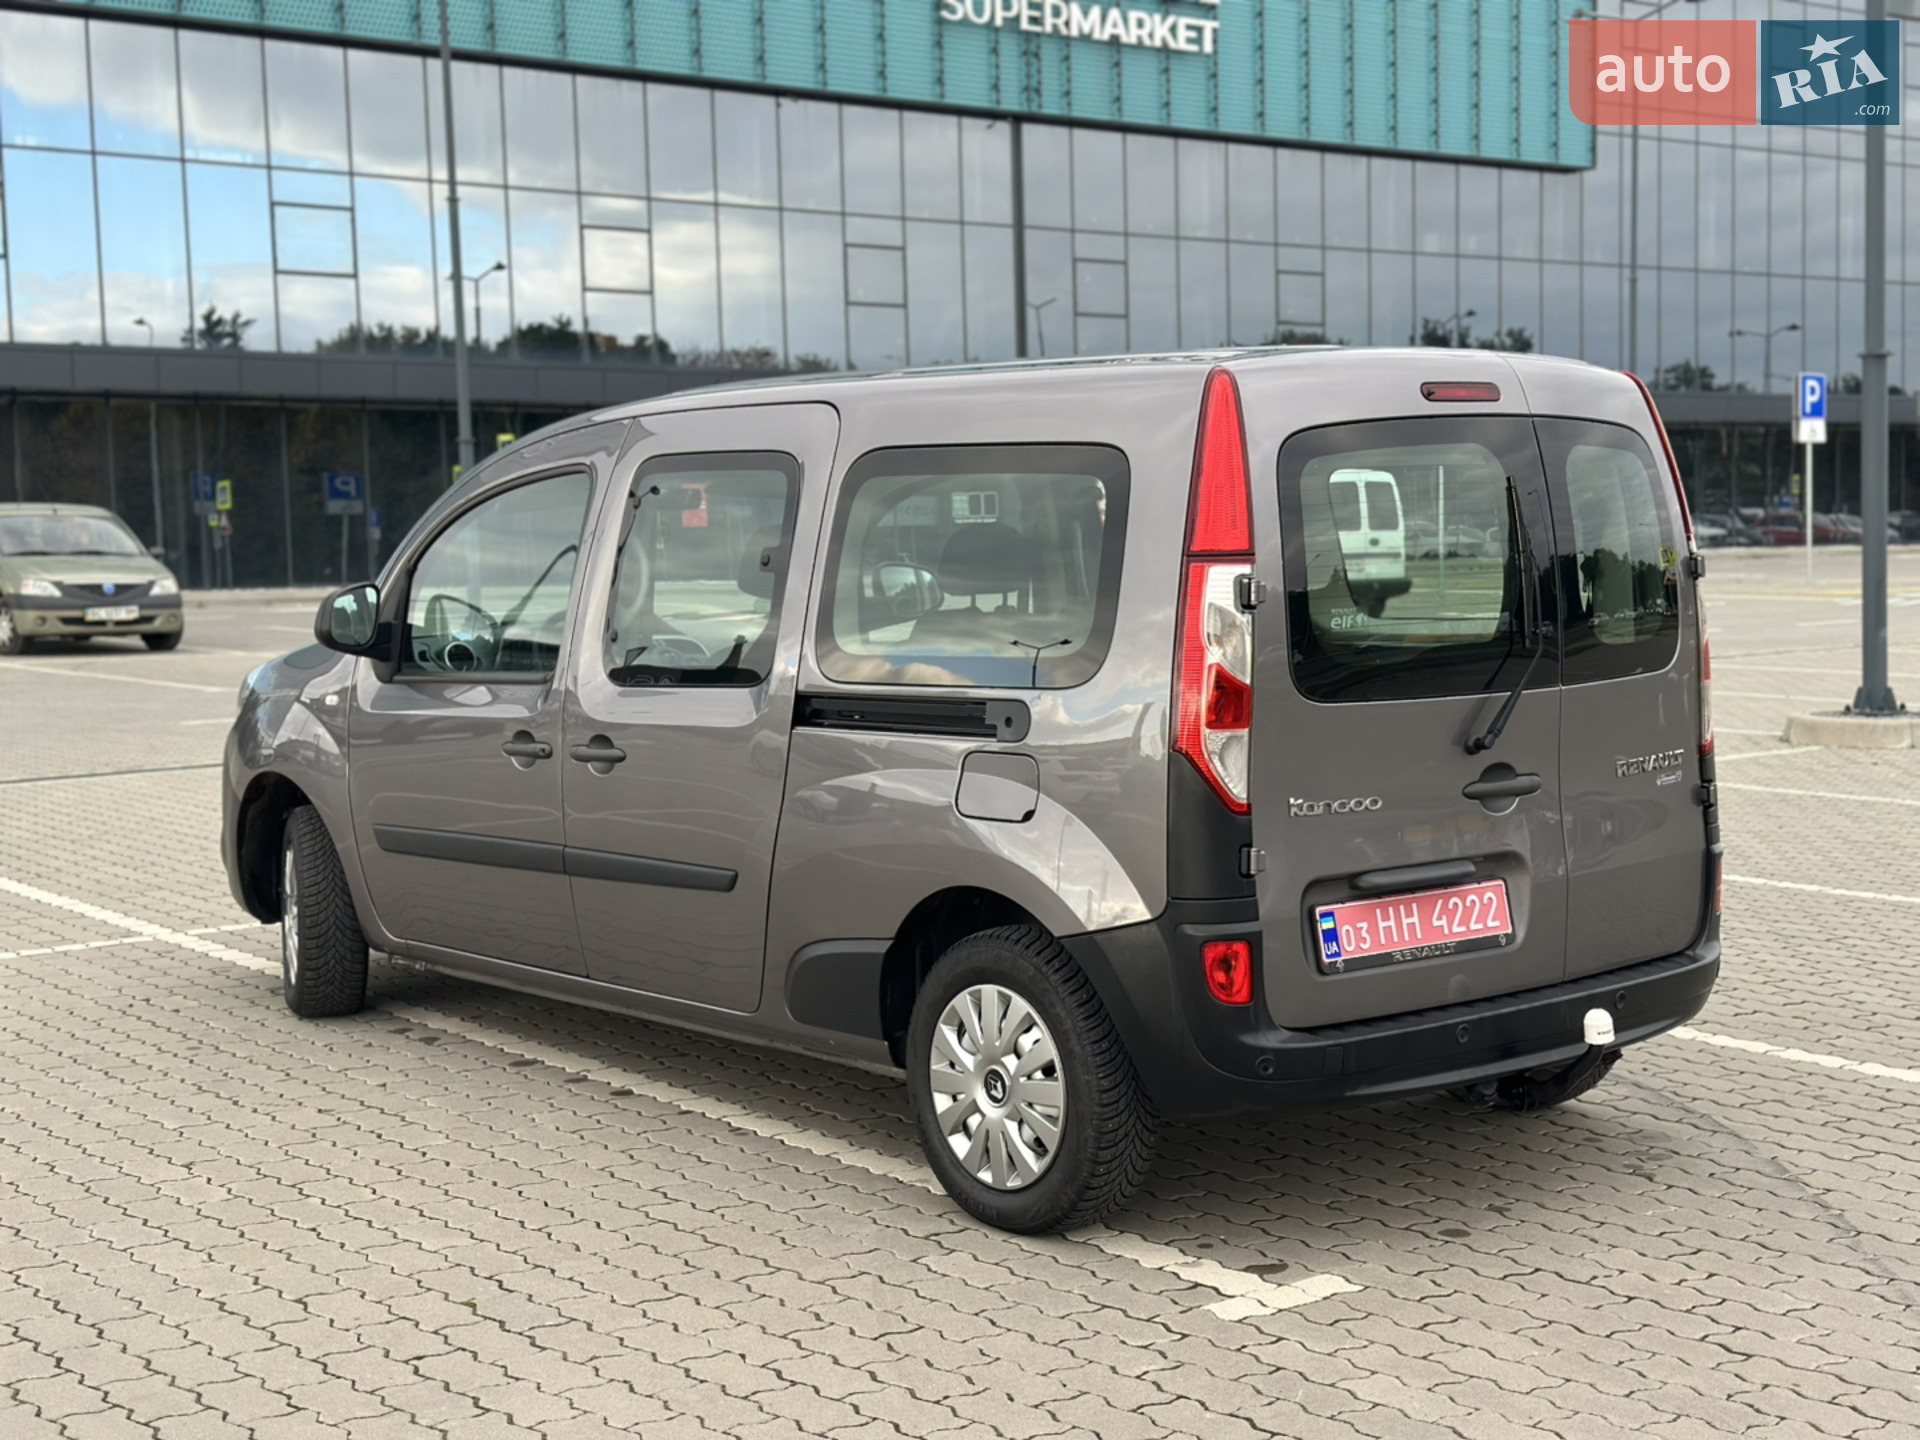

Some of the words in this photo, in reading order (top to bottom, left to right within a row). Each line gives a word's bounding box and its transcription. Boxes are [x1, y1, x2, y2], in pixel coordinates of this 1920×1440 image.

[940, 0, 1220, 54] SUPERMARKET
[1804, 378, 1821, 415] P
[1330, 614, 1355, 629] elf
[1615, 748, 1685, 779] RENAULT
[1341, 921, 1372, 952] 03
[1375, 901, 1423, 946] HH
[1432, 890, 1501, 936] 4222
[1325, 940, 1340, 956] UA
[1391, 942, 1457, 963] RENAULT
